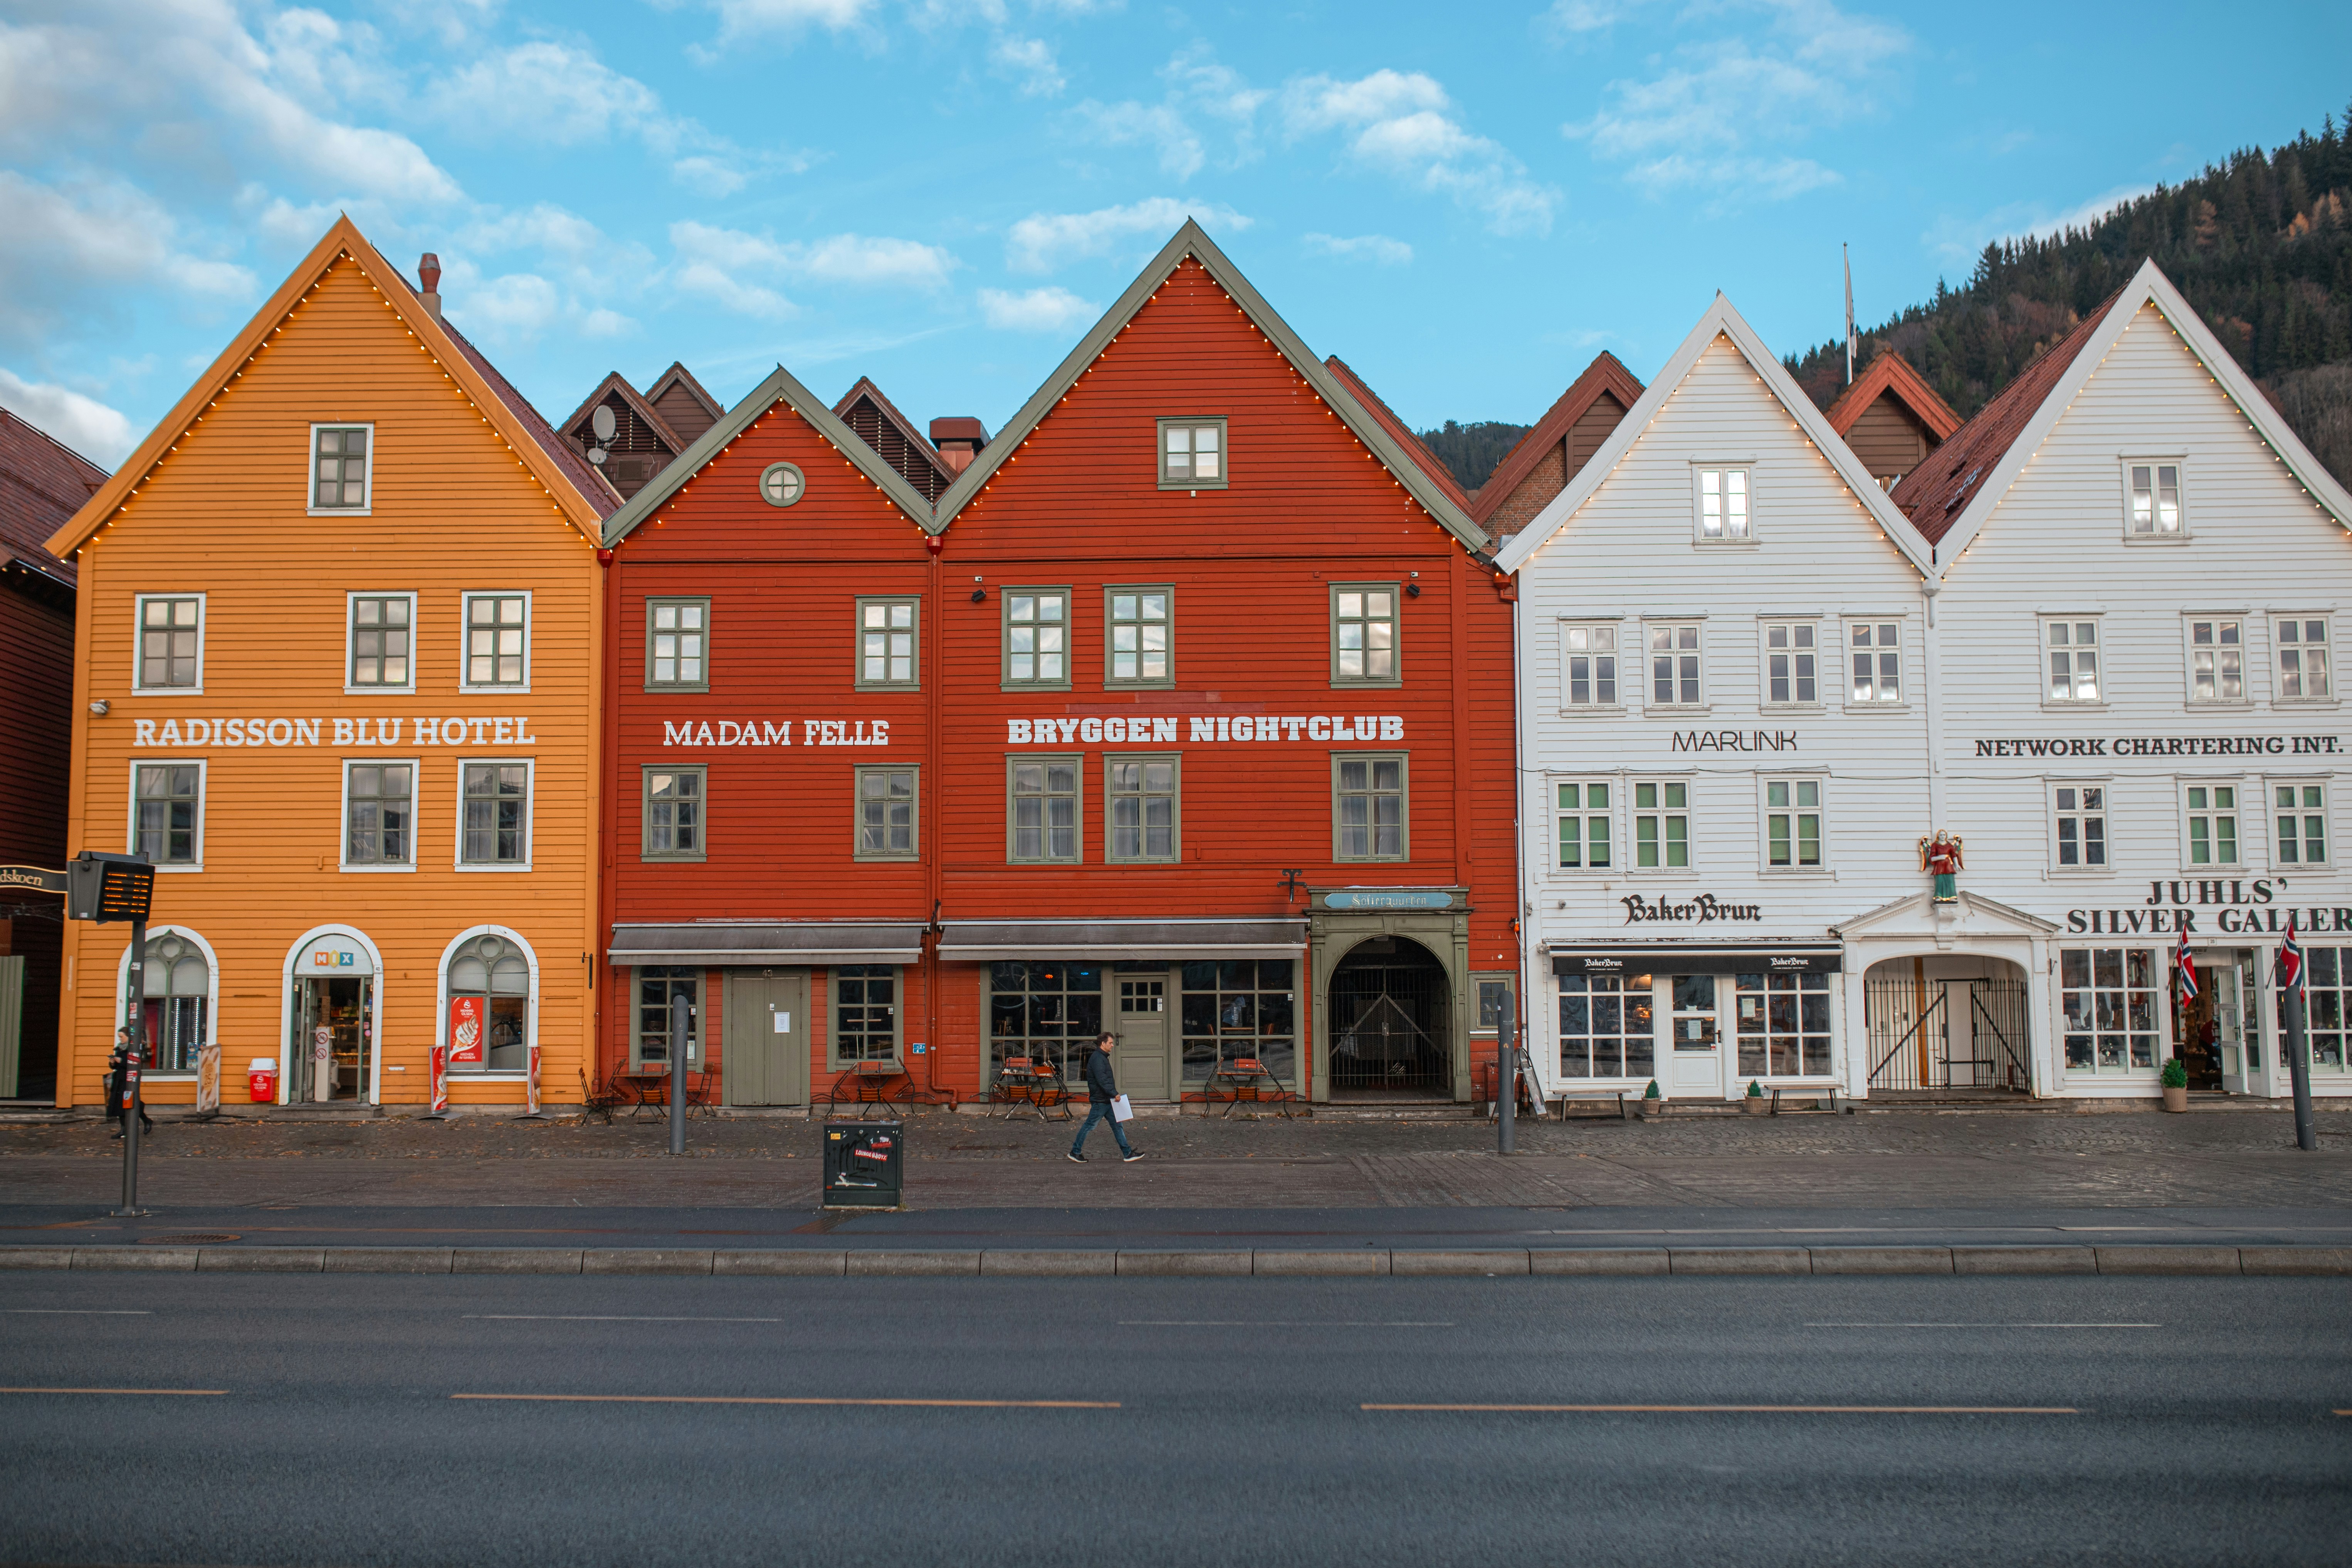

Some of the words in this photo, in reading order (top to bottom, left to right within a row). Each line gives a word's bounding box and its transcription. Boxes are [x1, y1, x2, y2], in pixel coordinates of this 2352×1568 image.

[133, 718, 323, 746] RADISSON
[331, 718, 404, 746] BLU
[412, 717, 536, 745] HOTEL
[663, 720, 792, 746] MADAM
[803, 720, 890, 746] FELLE
[1007, 717, 1178, 744] BRYGGEN
[1189, 716, 1404, 742] NIGHTCLUB
[1672, 731, 1797, 752] MARLINK
[1975, 739, 2107, 756] NETWORK
[2113, 737, 2285, 755] CHARTERING
[2291, 736, 2344, 754] INT.
[2068, 908, 2198, 934] SILVER
[316, 953, 351, 963] MIX
